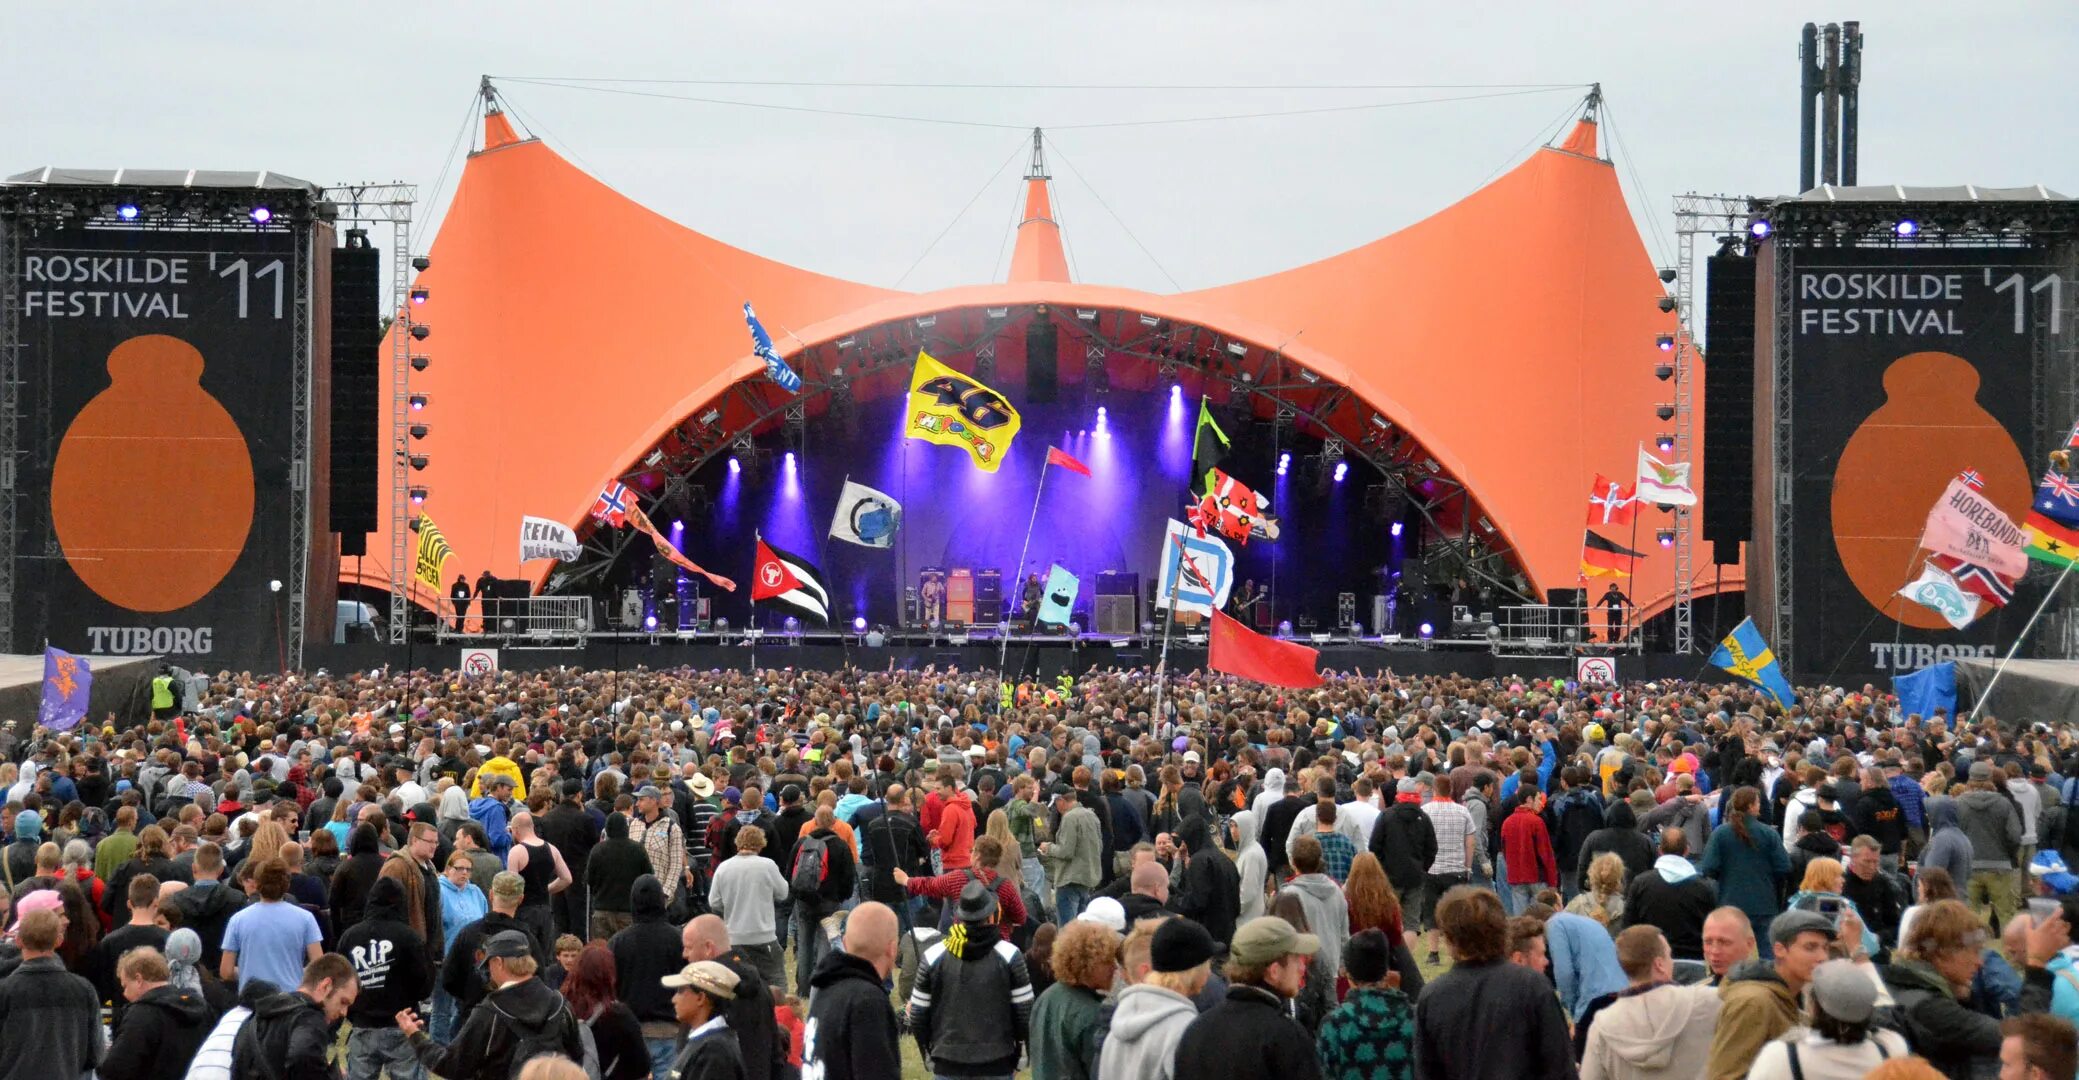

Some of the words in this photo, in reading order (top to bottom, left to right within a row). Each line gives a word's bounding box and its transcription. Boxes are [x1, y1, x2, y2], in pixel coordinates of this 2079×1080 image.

[25, 255, 188, 284] ROSKILDE
[1801, 273, 1963, 300] ROSKILDE
[25, 291, 189, 319] FESTIVAL
[1801, 308, 1963, 335] FESTIVAL
[87, 626, 212, 654] TUBORG
